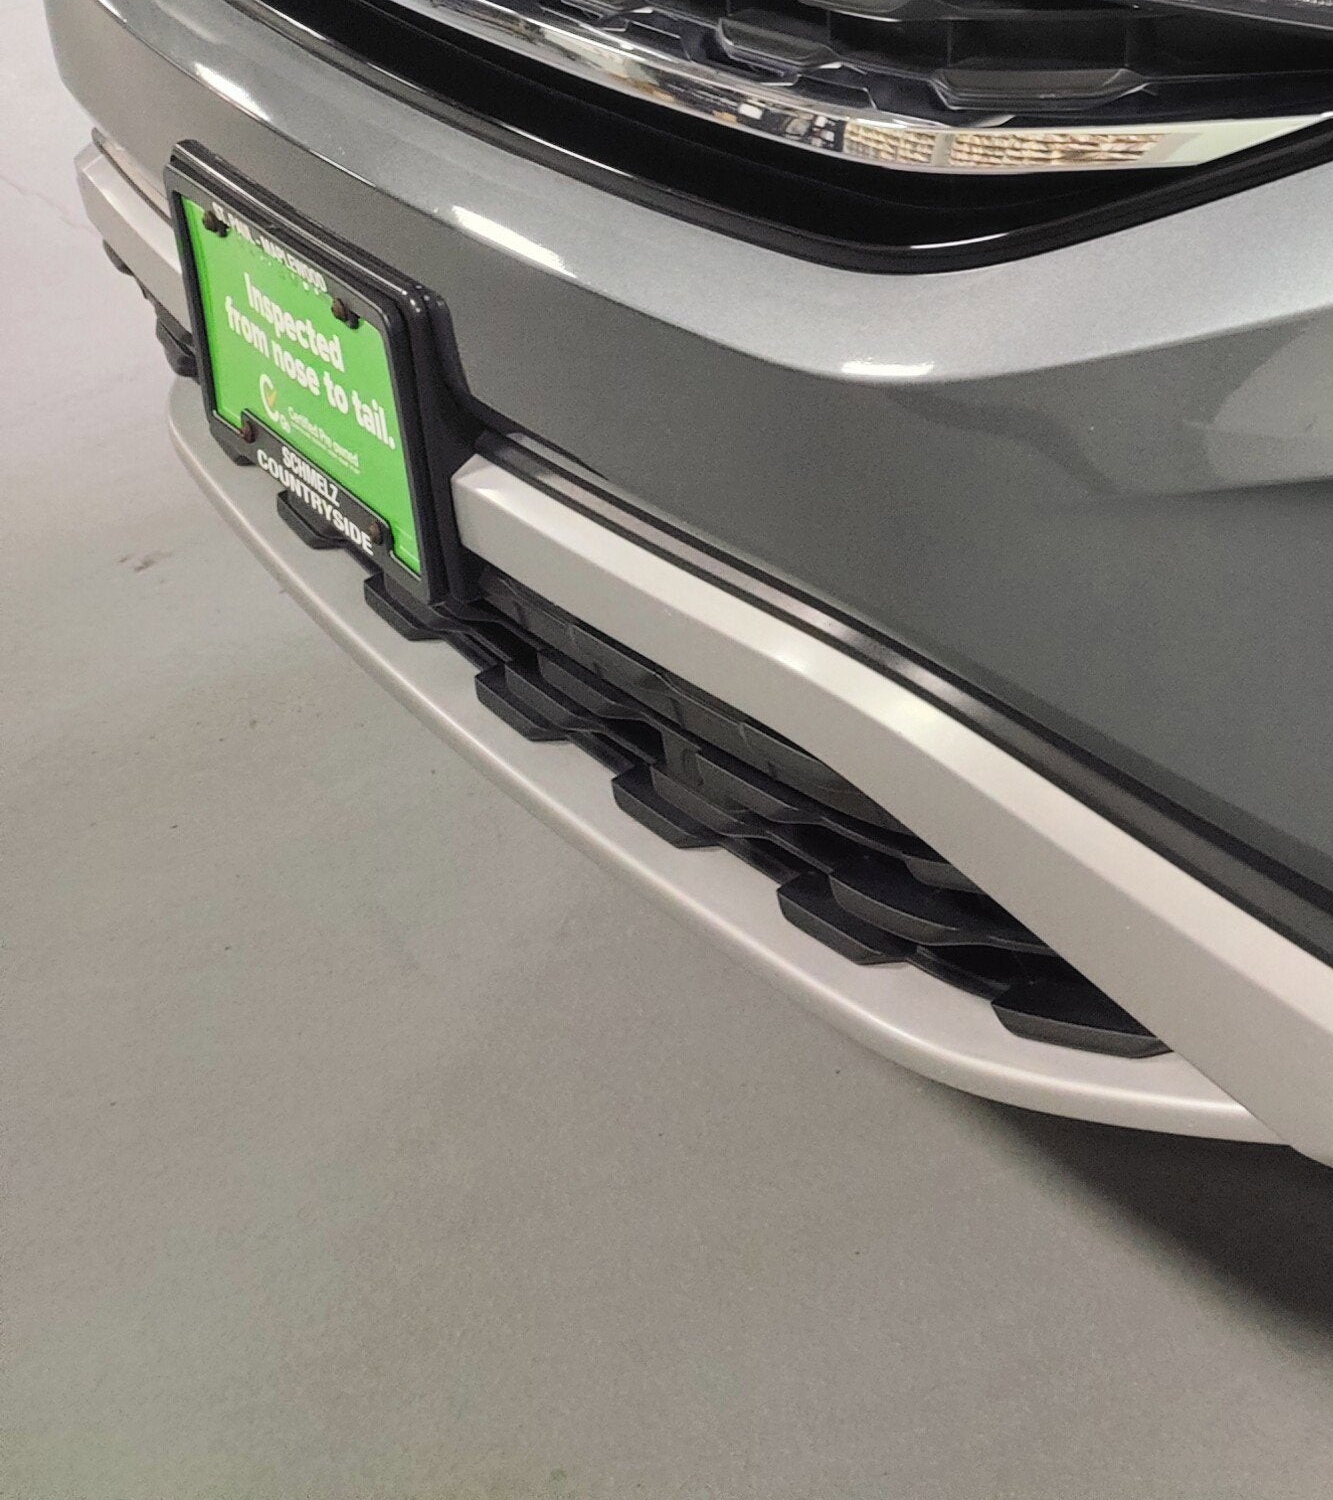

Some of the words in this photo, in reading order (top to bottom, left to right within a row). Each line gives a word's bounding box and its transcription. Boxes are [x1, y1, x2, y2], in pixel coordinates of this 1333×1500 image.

[225, 295, 270, 358] from
[271, 340, 320, 395] nose
[323, 371, 349, 414] to
[351, 389, 396, 449] tail.
[244, 272, 345, 372] Inspected
[257, 449, 374, 556] COUNTRYSIDE
[281, 446, 340, 507] SCHMELZ
